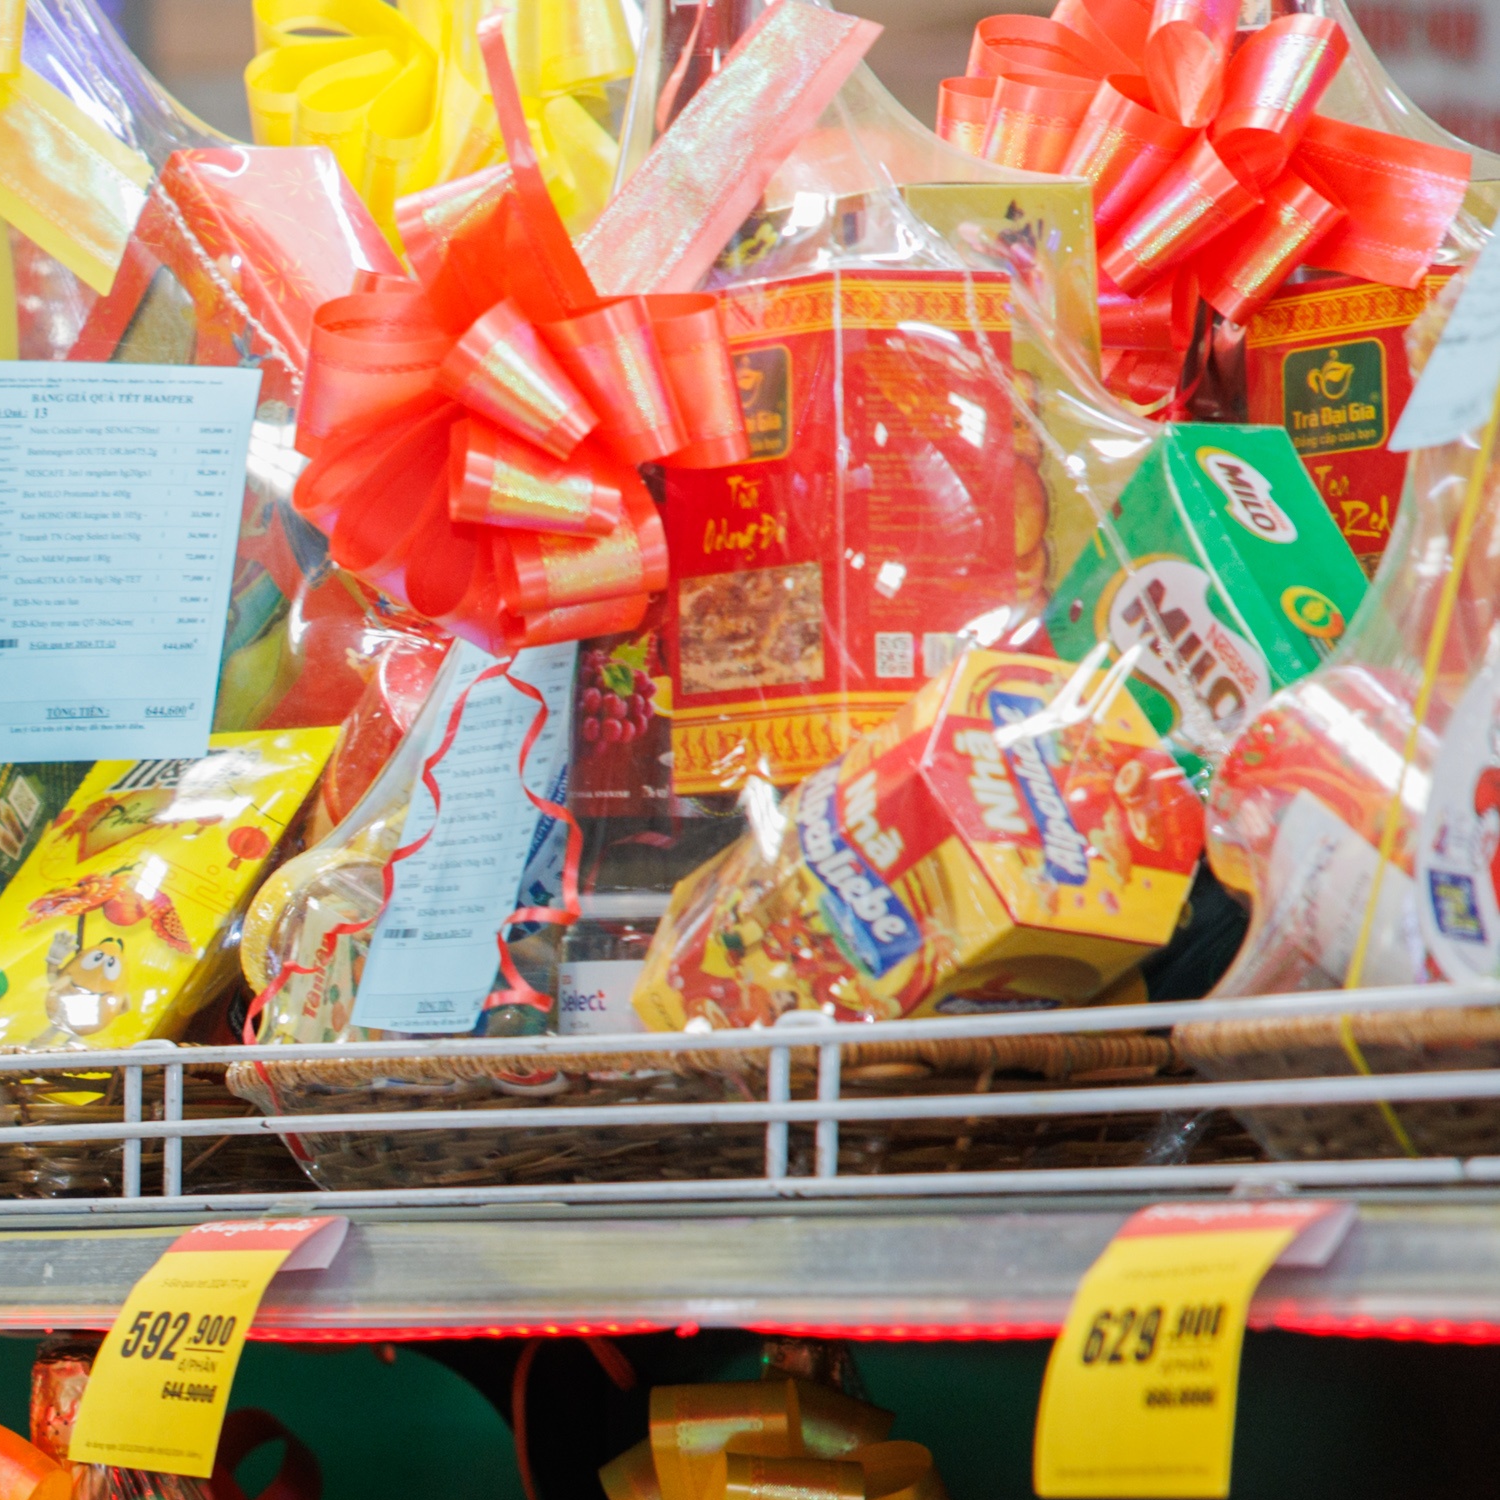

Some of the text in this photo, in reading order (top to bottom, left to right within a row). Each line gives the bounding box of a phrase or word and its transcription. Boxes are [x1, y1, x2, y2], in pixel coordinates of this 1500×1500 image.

[33, 407, 48, 419] 13
[143, 394, 194, 405] HAMPER
[1349, 401, 1376, 422] Gia
[1216, 461, 1277, 533] MILO
[1122, 577, 1247, 726] MILO
[955, 728, 1029, 835] Nhã
[843, 768, 906, 871] Nhã
[801, 768, 908, 944] Alpenliebe
[120, 1311, 191, 1361] 592
[1081, 1306, 1163, 1366] 629
